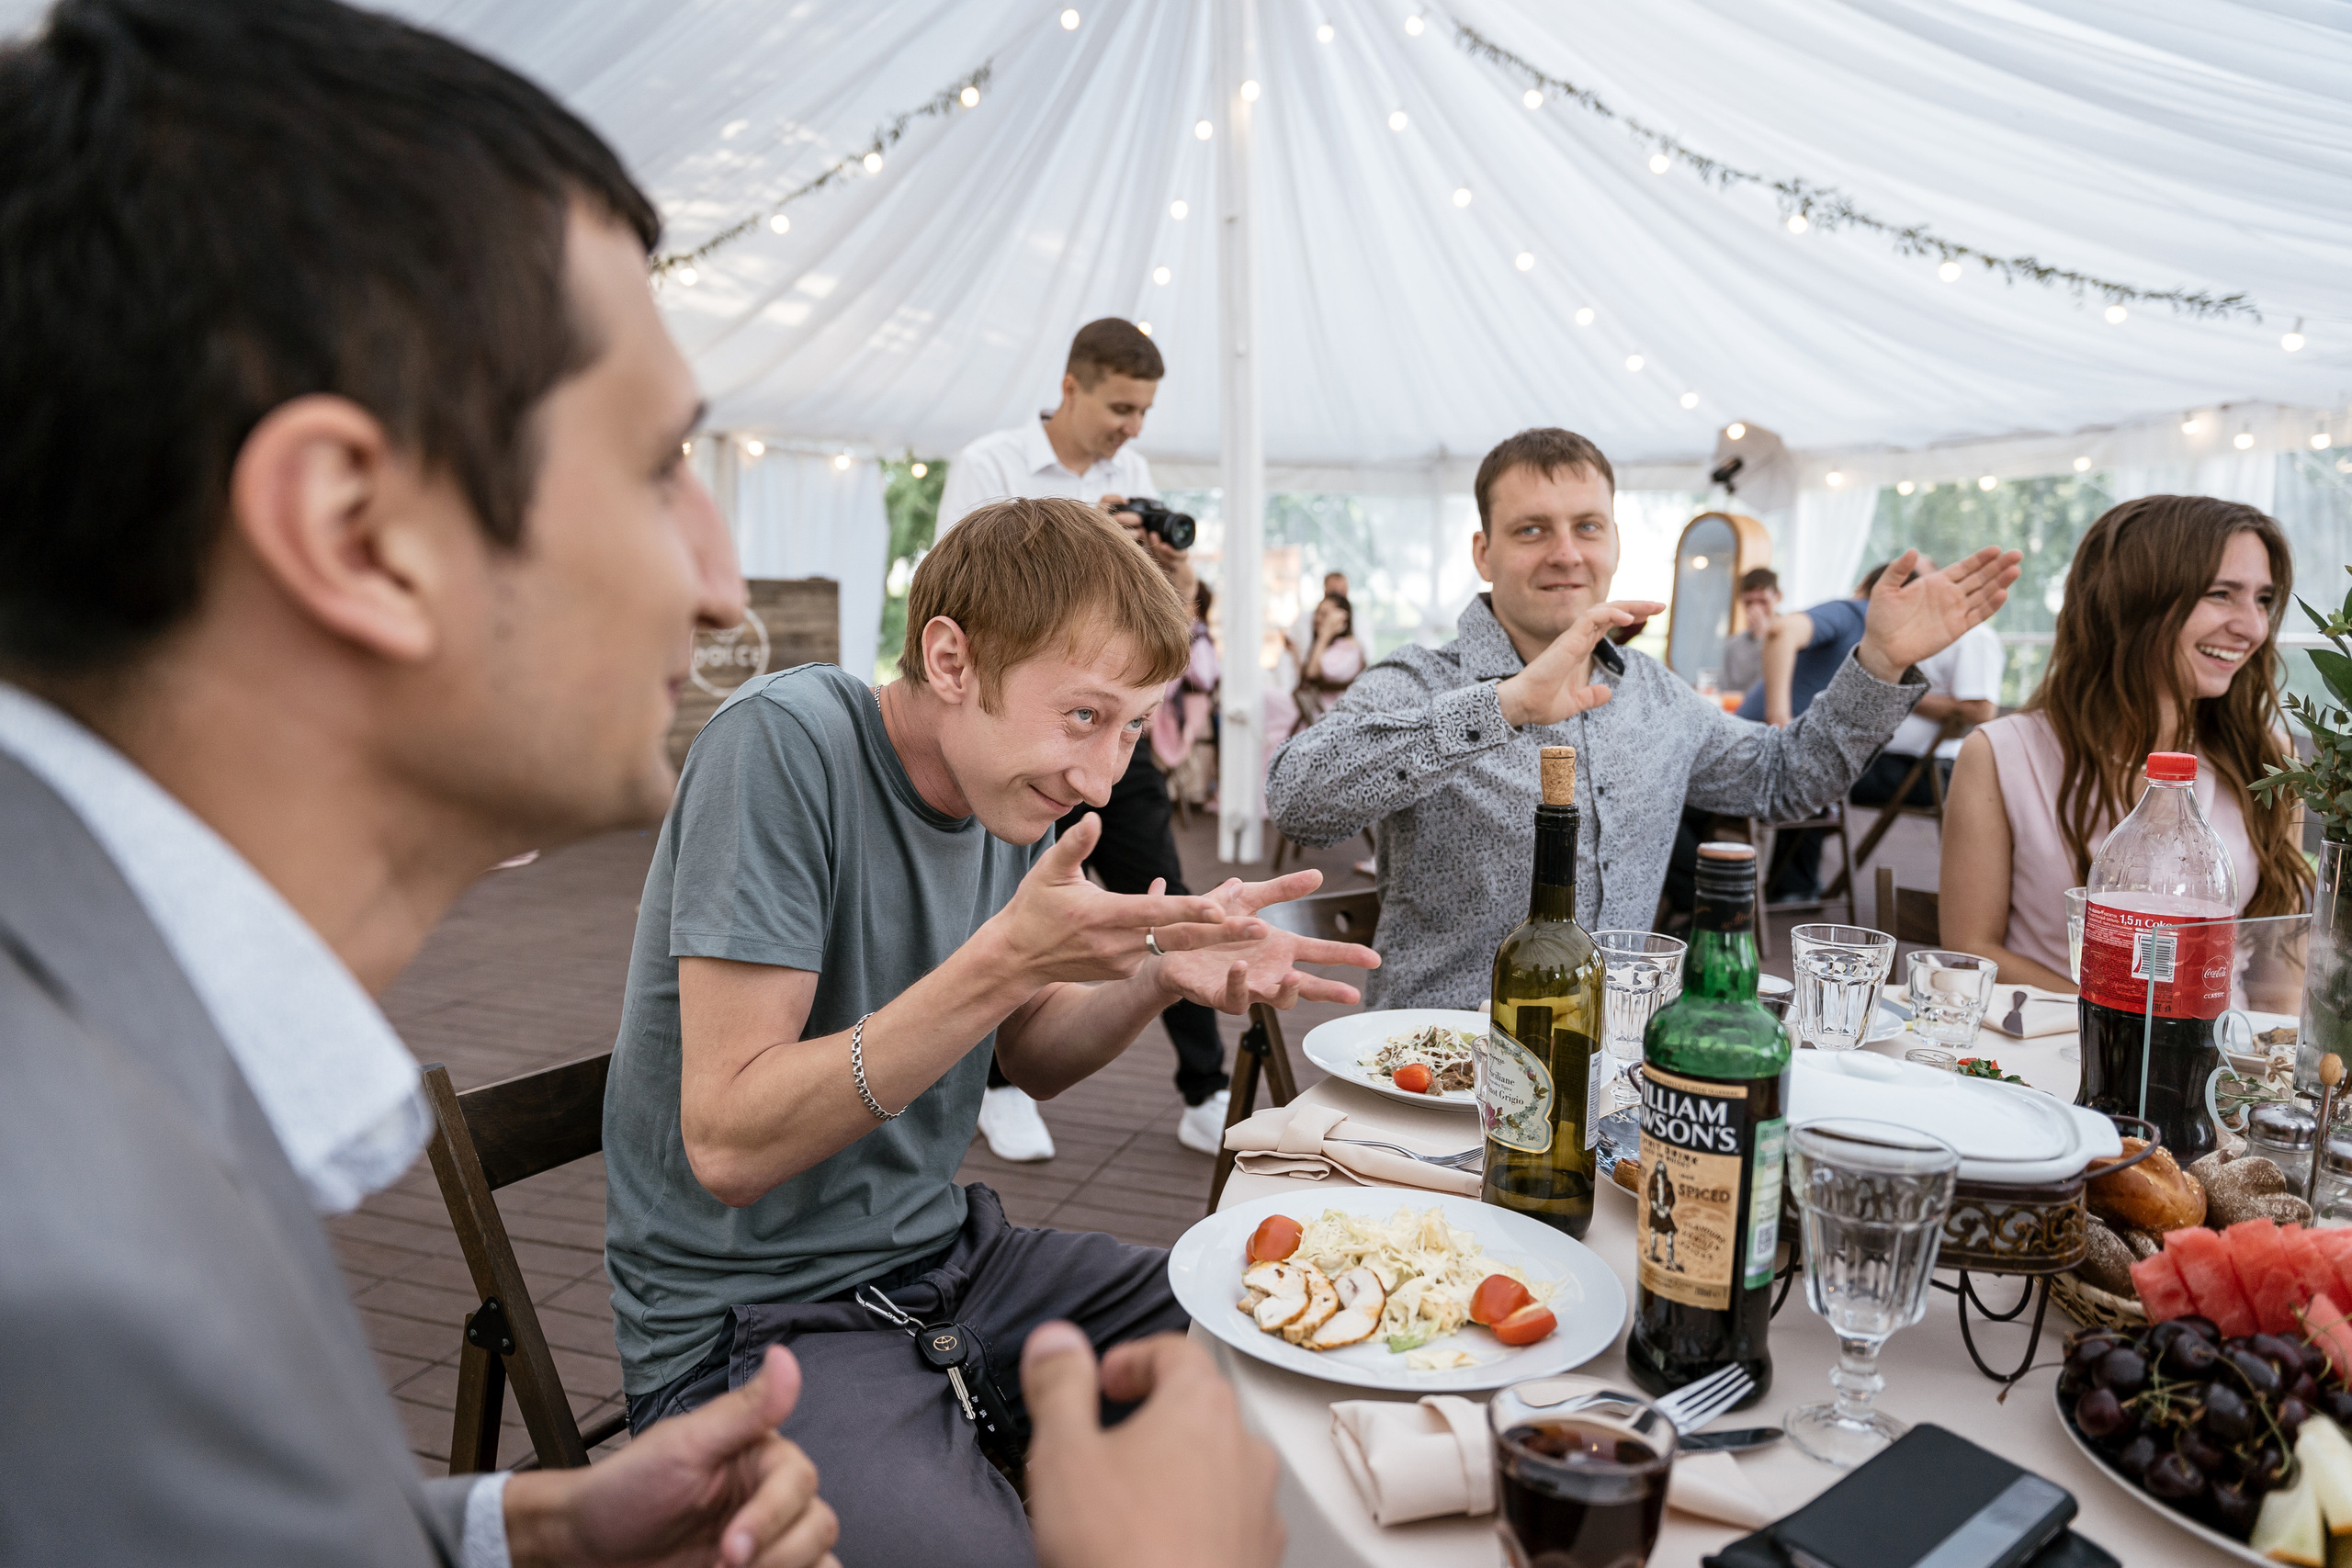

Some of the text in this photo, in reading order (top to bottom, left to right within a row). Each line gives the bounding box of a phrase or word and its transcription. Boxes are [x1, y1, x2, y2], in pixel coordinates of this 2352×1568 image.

[2120, 914, 2133, 925] 1,5
[2204, 966, 2226, 978] Coca-Cola
[2203, 991, 2224, 999] CLASSIC
[1498, 1089, 1524, 1105] Grigio
[1641, 1103, 1736, 1152] WSON'S
[1678, 1183, 1731, 1203] SPICED
